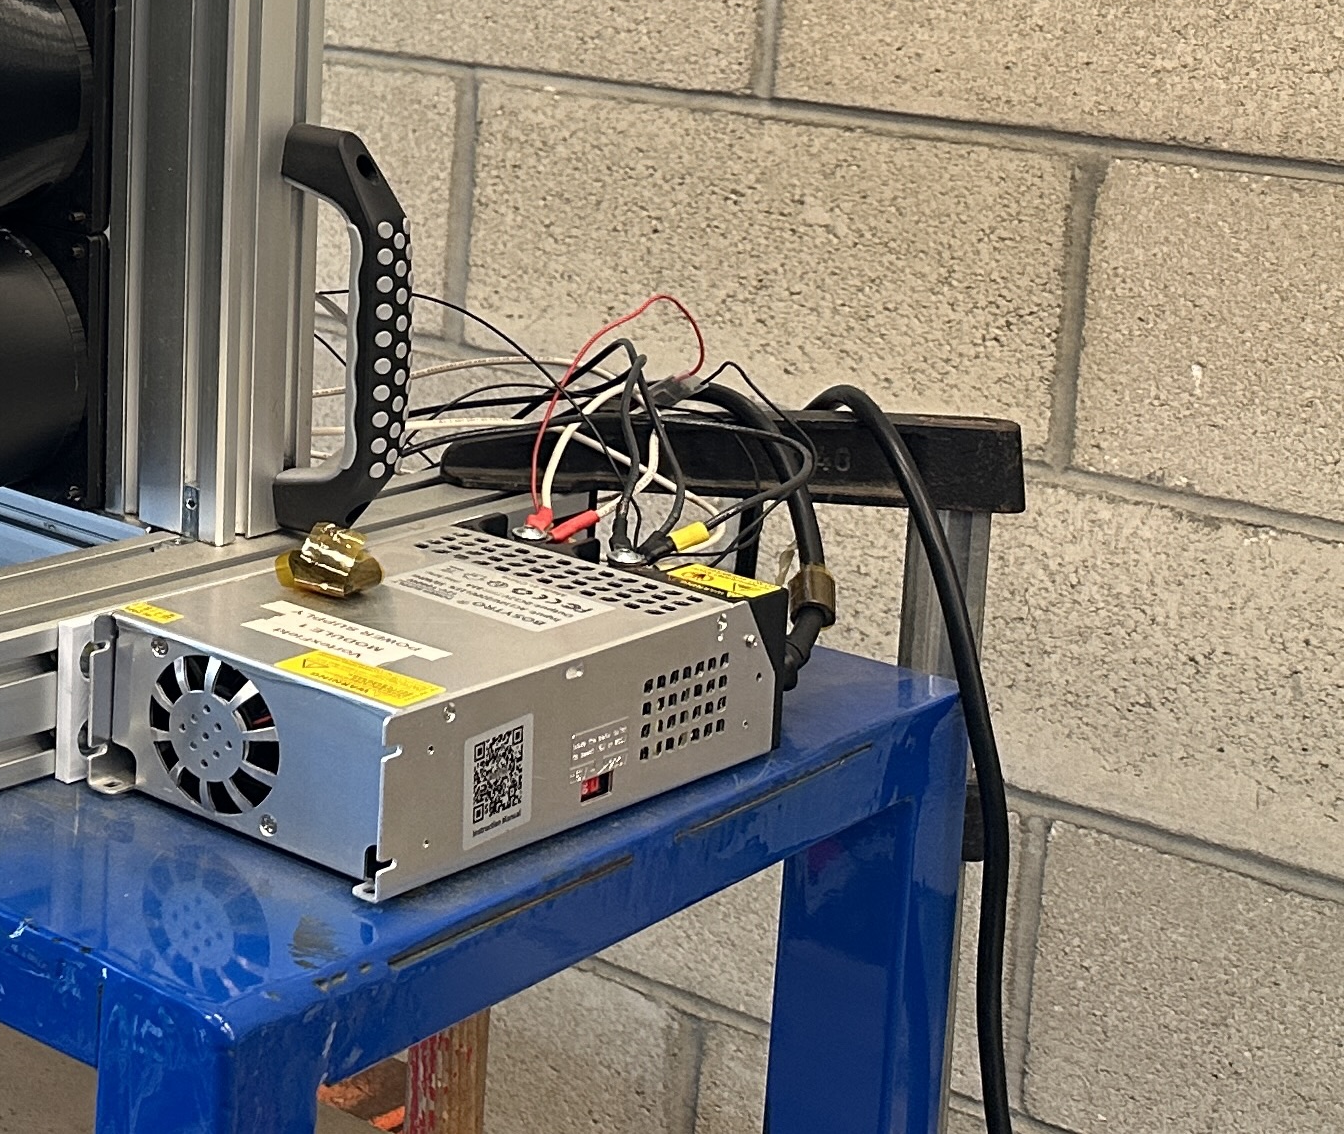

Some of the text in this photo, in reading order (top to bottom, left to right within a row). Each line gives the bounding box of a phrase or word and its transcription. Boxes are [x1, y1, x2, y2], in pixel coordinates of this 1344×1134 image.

[472, 601, 547, 626] BOSYTRO
[291, 609, 423, 652] POWER SUPPLY
[311, 628, 385, 652] MODULE
